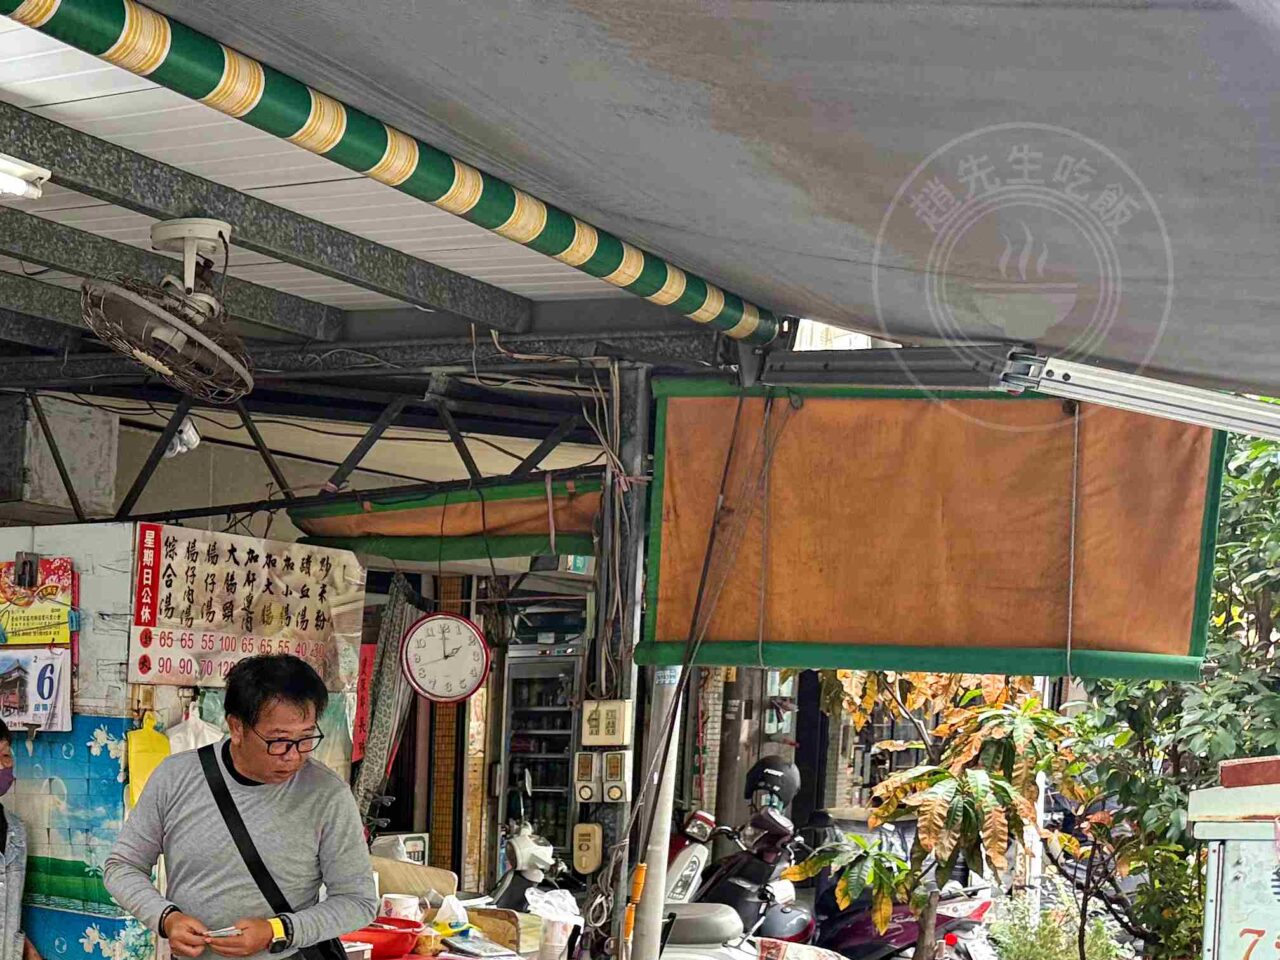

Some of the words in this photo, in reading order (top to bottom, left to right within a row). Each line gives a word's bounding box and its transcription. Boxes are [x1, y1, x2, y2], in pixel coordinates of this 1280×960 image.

[140, 530, 156, 624] 星期日公休
[159, 631, 173, 648] 65
[180, 633, 194, 649] 65
[201, 634, 215, 650] 55
[219, 636, 237, 652] 100
[241, 637, 254, 653] 65
[260, 639, 273, 655] 65
[278, 640, 290, 655] 55
[295, 642, 306, 657] 40
[37, 663, 55, 700] 6
[158, 657, 172, 674] 90
[179, 658, 193, 675] 90
[201, 659, 213, 676] 70
